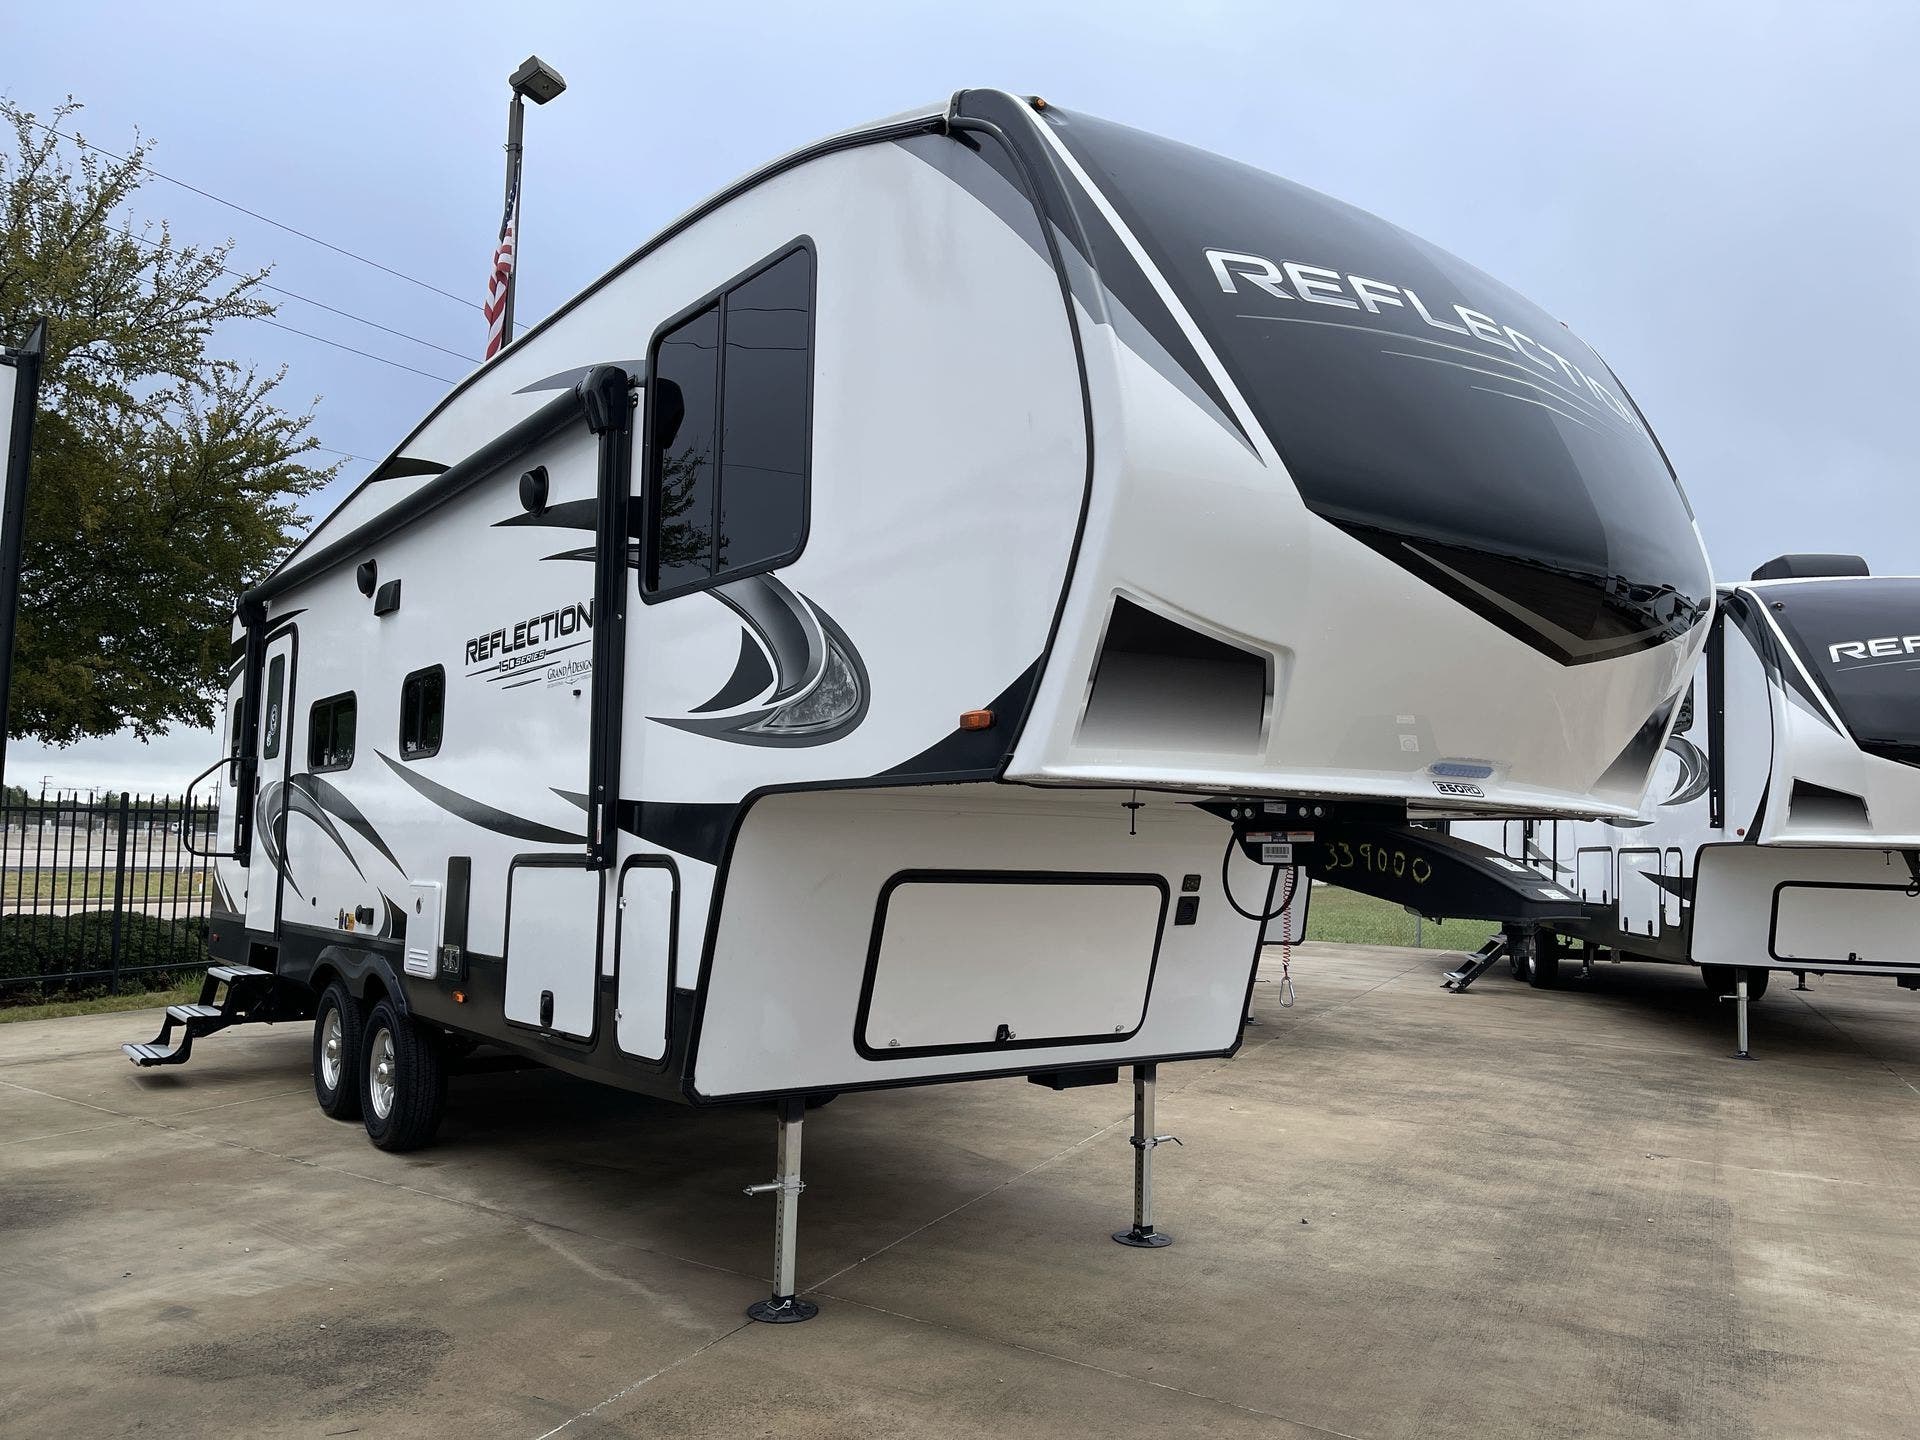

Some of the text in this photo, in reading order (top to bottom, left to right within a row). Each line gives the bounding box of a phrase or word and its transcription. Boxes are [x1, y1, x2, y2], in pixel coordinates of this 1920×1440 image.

[1204, 247, 1647, 434] REFLECTION
[465, 598, 594, 666] REFLECTION
[547, 665, 568, 680] GRAND
[1436, 783, 1482, 796] 260RD
[1323, 842, 1432, 884] 339000
